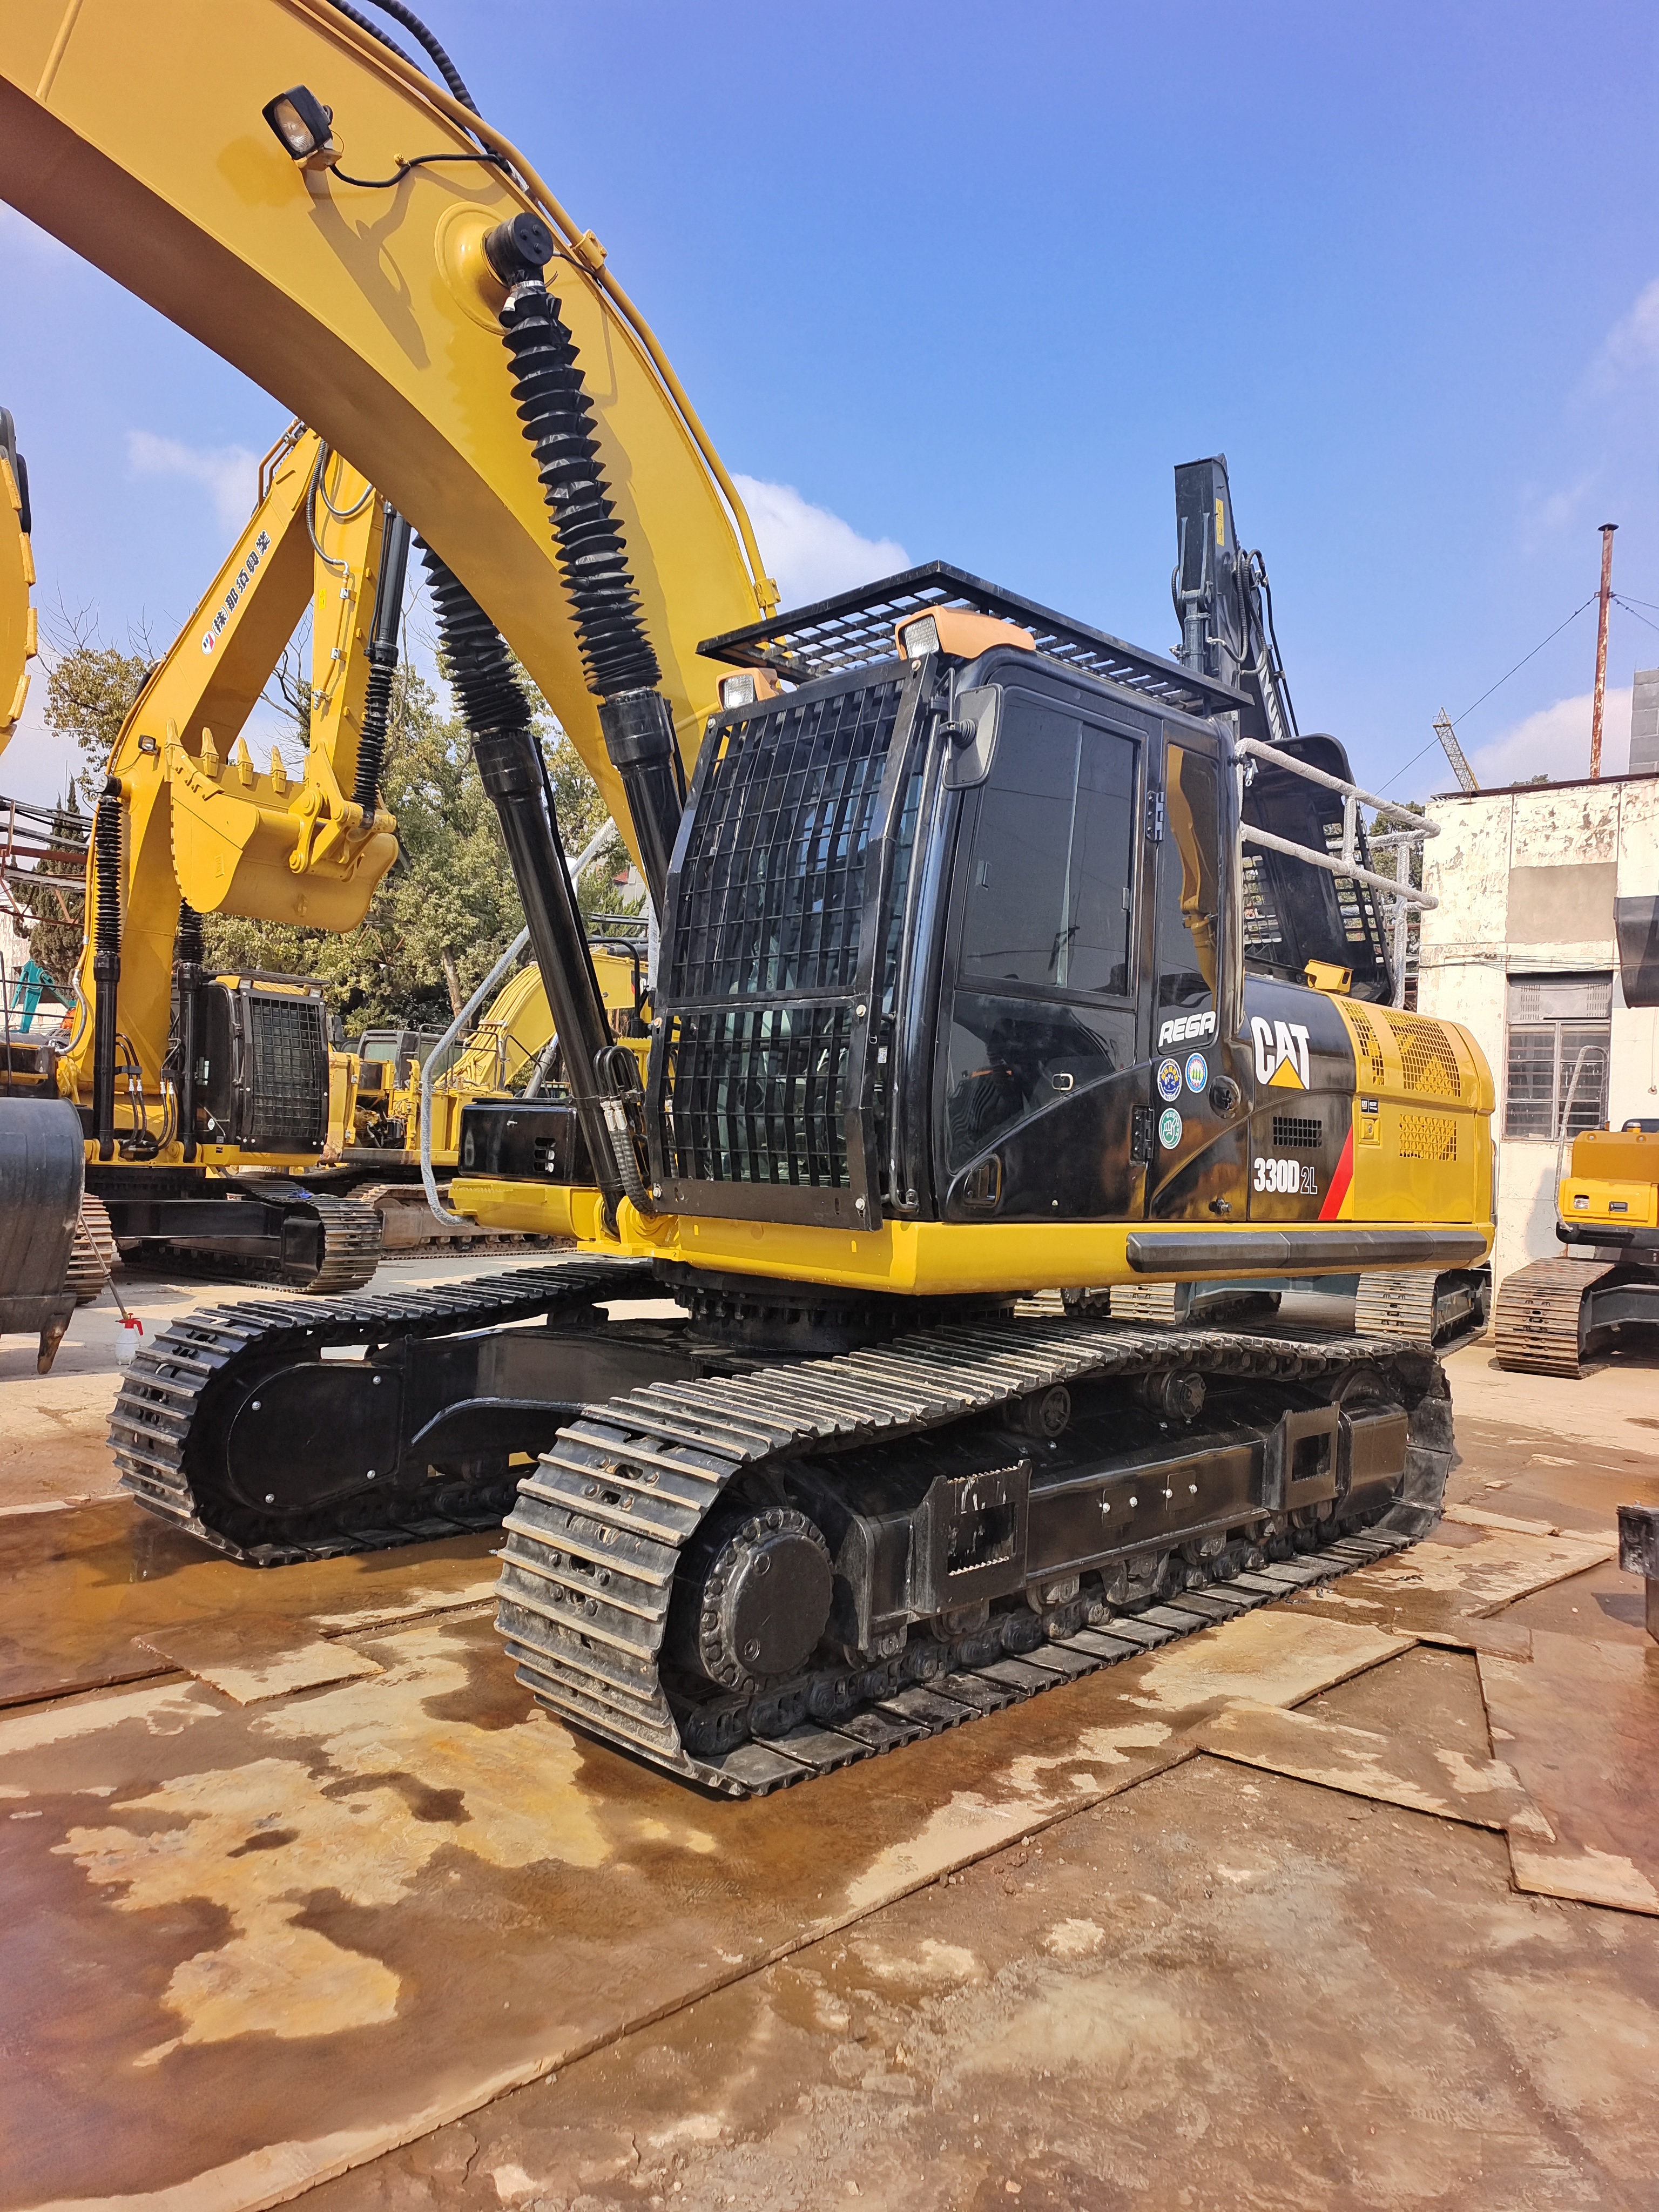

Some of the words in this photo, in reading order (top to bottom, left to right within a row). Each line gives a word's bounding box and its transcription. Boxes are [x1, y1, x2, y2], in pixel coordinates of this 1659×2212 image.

[1257, 651, 1284, 739] HYUN
[1158, 1010, 1216, 1048] REGA
[1251, 1016, 1310, 1090] CAT
